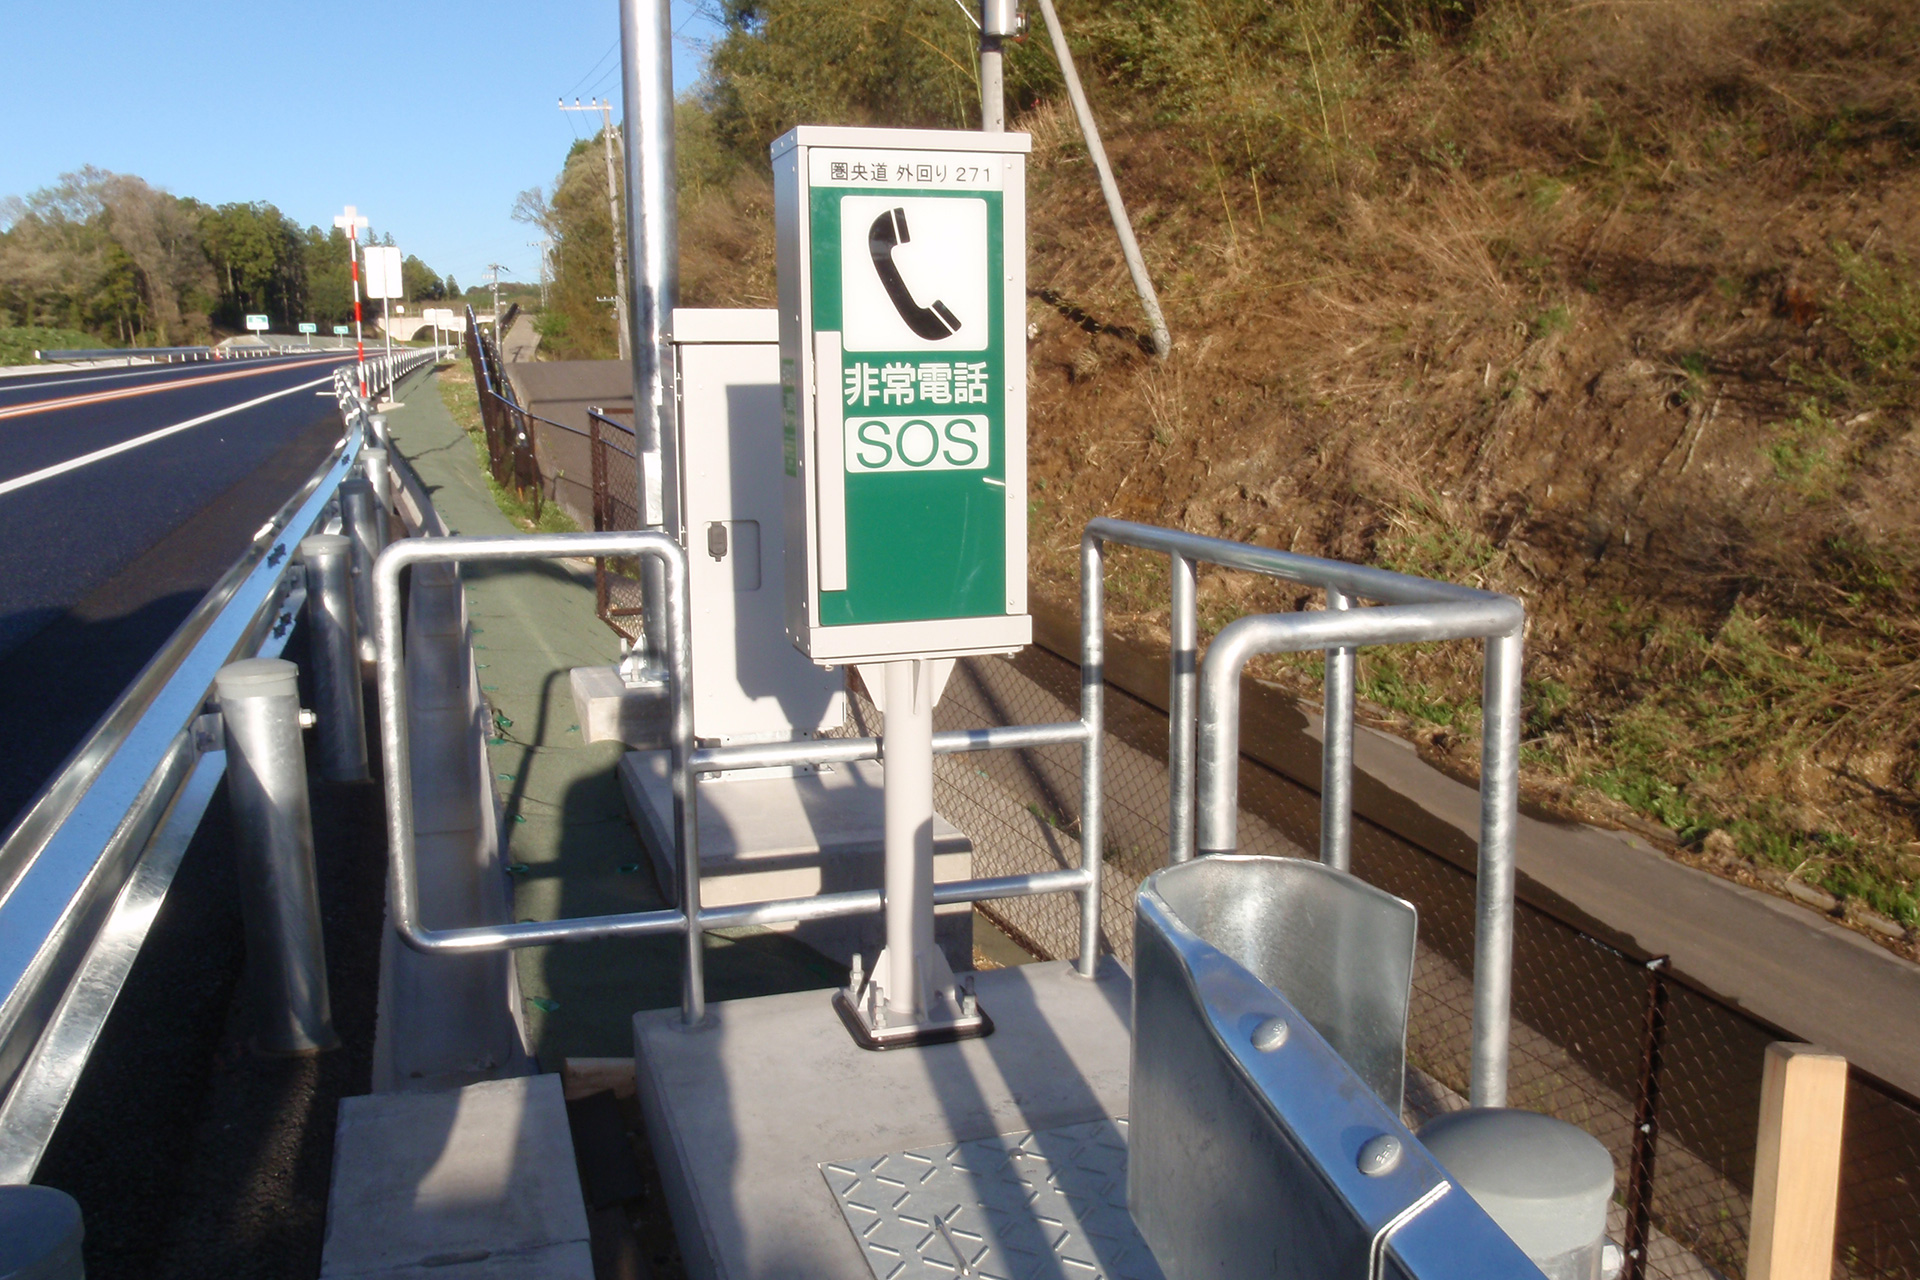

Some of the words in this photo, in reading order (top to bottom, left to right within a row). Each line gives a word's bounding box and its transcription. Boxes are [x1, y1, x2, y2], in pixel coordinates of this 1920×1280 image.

[830, 161, 888, 182] 圏央道
[897, 163, 947, 183] 外回り
[956, 167, 990, 182] 271
[844, 362, 988, 406] 非常電話
[856, 419, 978, 468] SOS
